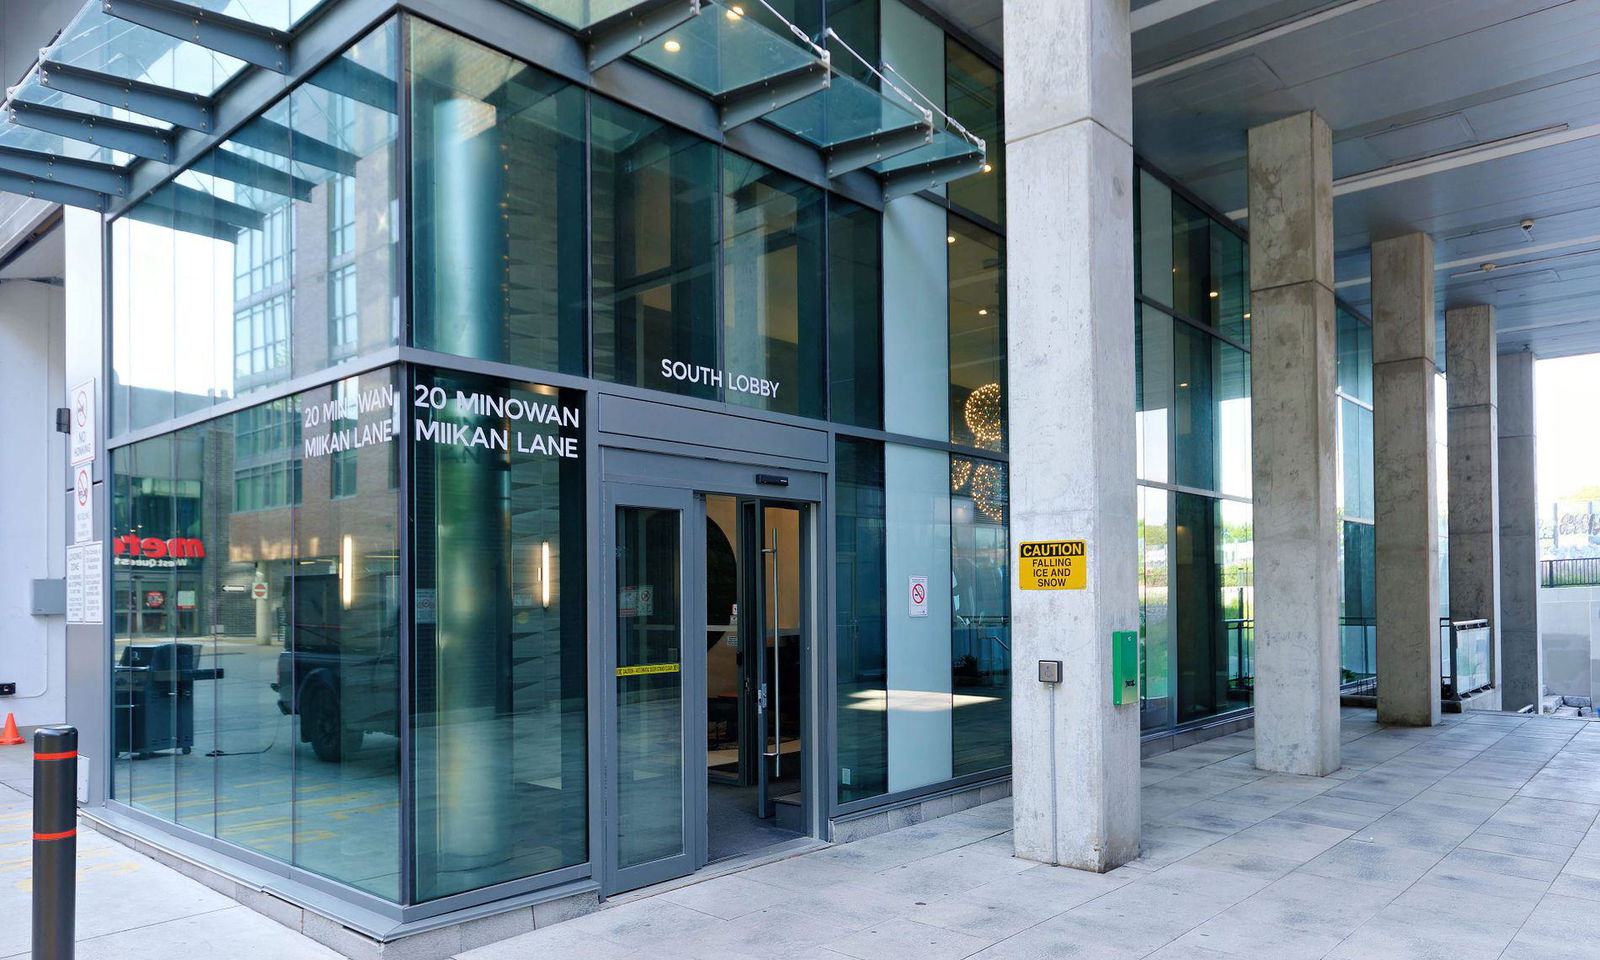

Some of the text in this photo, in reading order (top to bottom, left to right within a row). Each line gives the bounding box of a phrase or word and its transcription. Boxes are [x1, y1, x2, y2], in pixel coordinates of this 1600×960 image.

[661, 358, 780, 398] SOUTH LOBBY
[304, 384, 393, 428] 20 MINWAN
[414, 384, 580, 428] 20 MINOWAN
[304, 418, 393, 459] MIIKAN LANE
[415, 419, 579, 459] MIIKAN LANE
[1022, 543, 1082, 557] CAUTION
[1032, 558, 1072, 567] FALLING
[1033, 568, 1071, 577] ICE AND
[1038, 578, 1067, 587] SNOW
